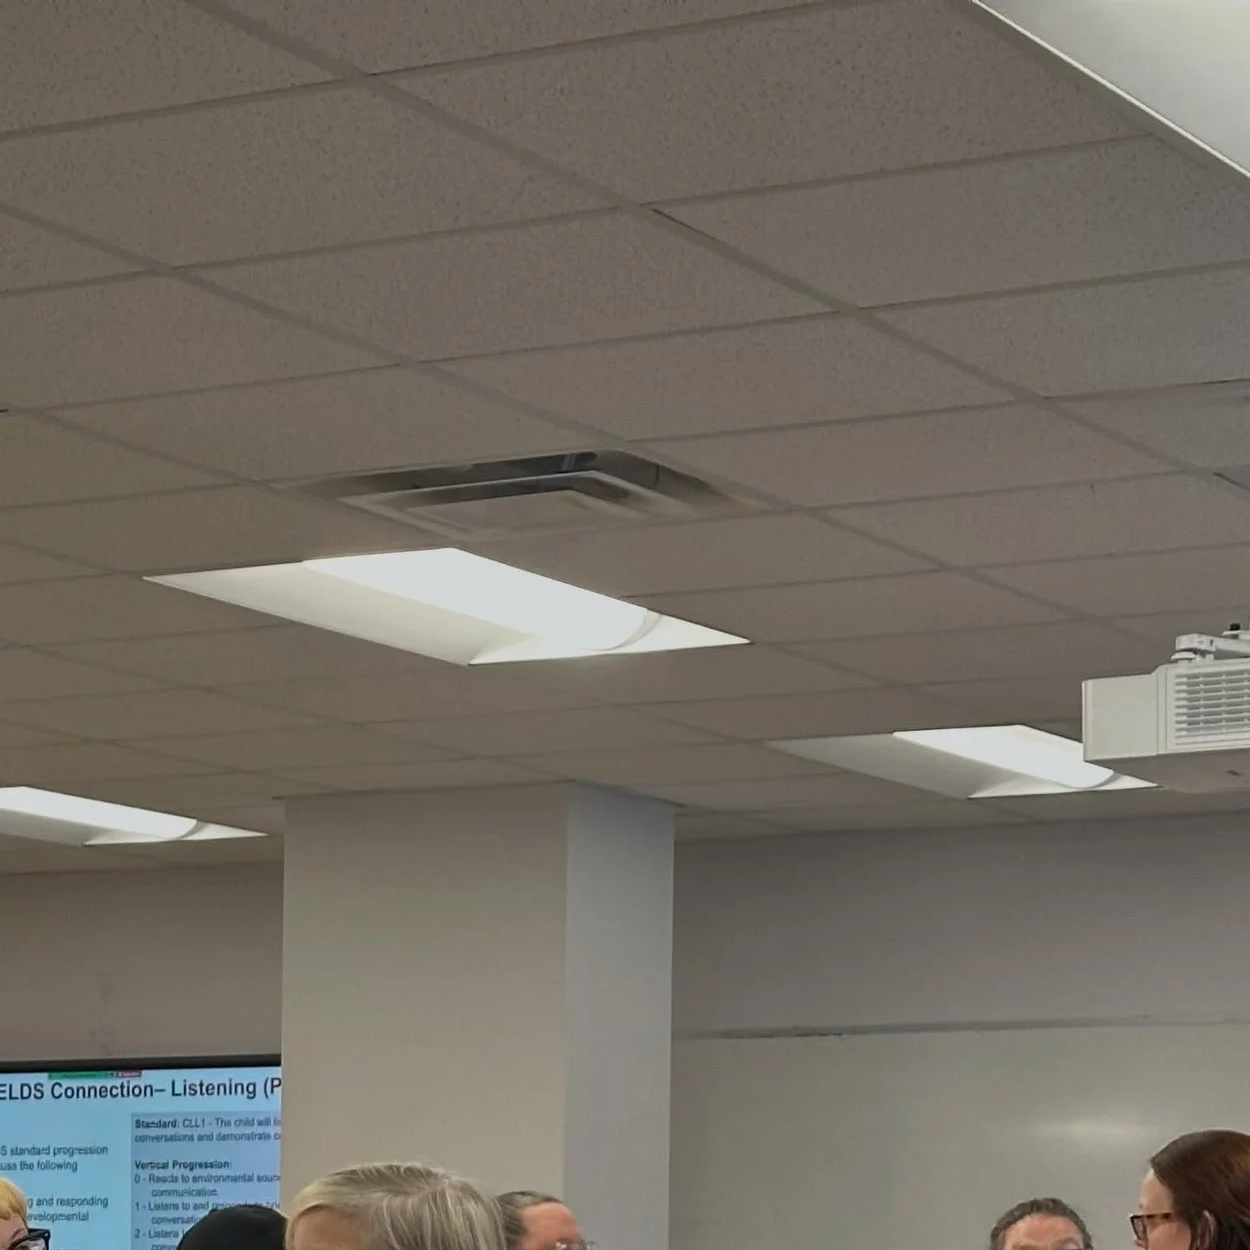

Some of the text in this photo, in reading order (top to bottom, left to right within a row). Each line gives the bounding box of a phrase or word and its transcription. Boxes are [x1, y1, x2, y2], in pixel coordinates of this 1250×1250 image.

[171, 1078, 257, 1099] Listening
[215, 1117, 232, 1128] The
[234, 1116, 255, 1127] child
[257, 1116, 272, 1127] will
[135, 1132, 195, 1143] conversations
[197, 1132, 214, 1142] and
[216, 1131, 271, 1142] demonstrate
[10, 1145, 50, 1156] standard
[53, 1144, 108, 1157] progression
[20, 1159, 35, 1170] the
[37, 1159, 78, 1172] following
[181, 1174, 190, 1183] to
[192, 1173, 254, 1183] environmental
[36, 1196, 54, 1207] and
[56, 1195, 109, 1208] responding
[148, 1201, 180, 1211] Listens
[182, 1201, 191, 1211] to
[193, 1201, 210, 1210] and
